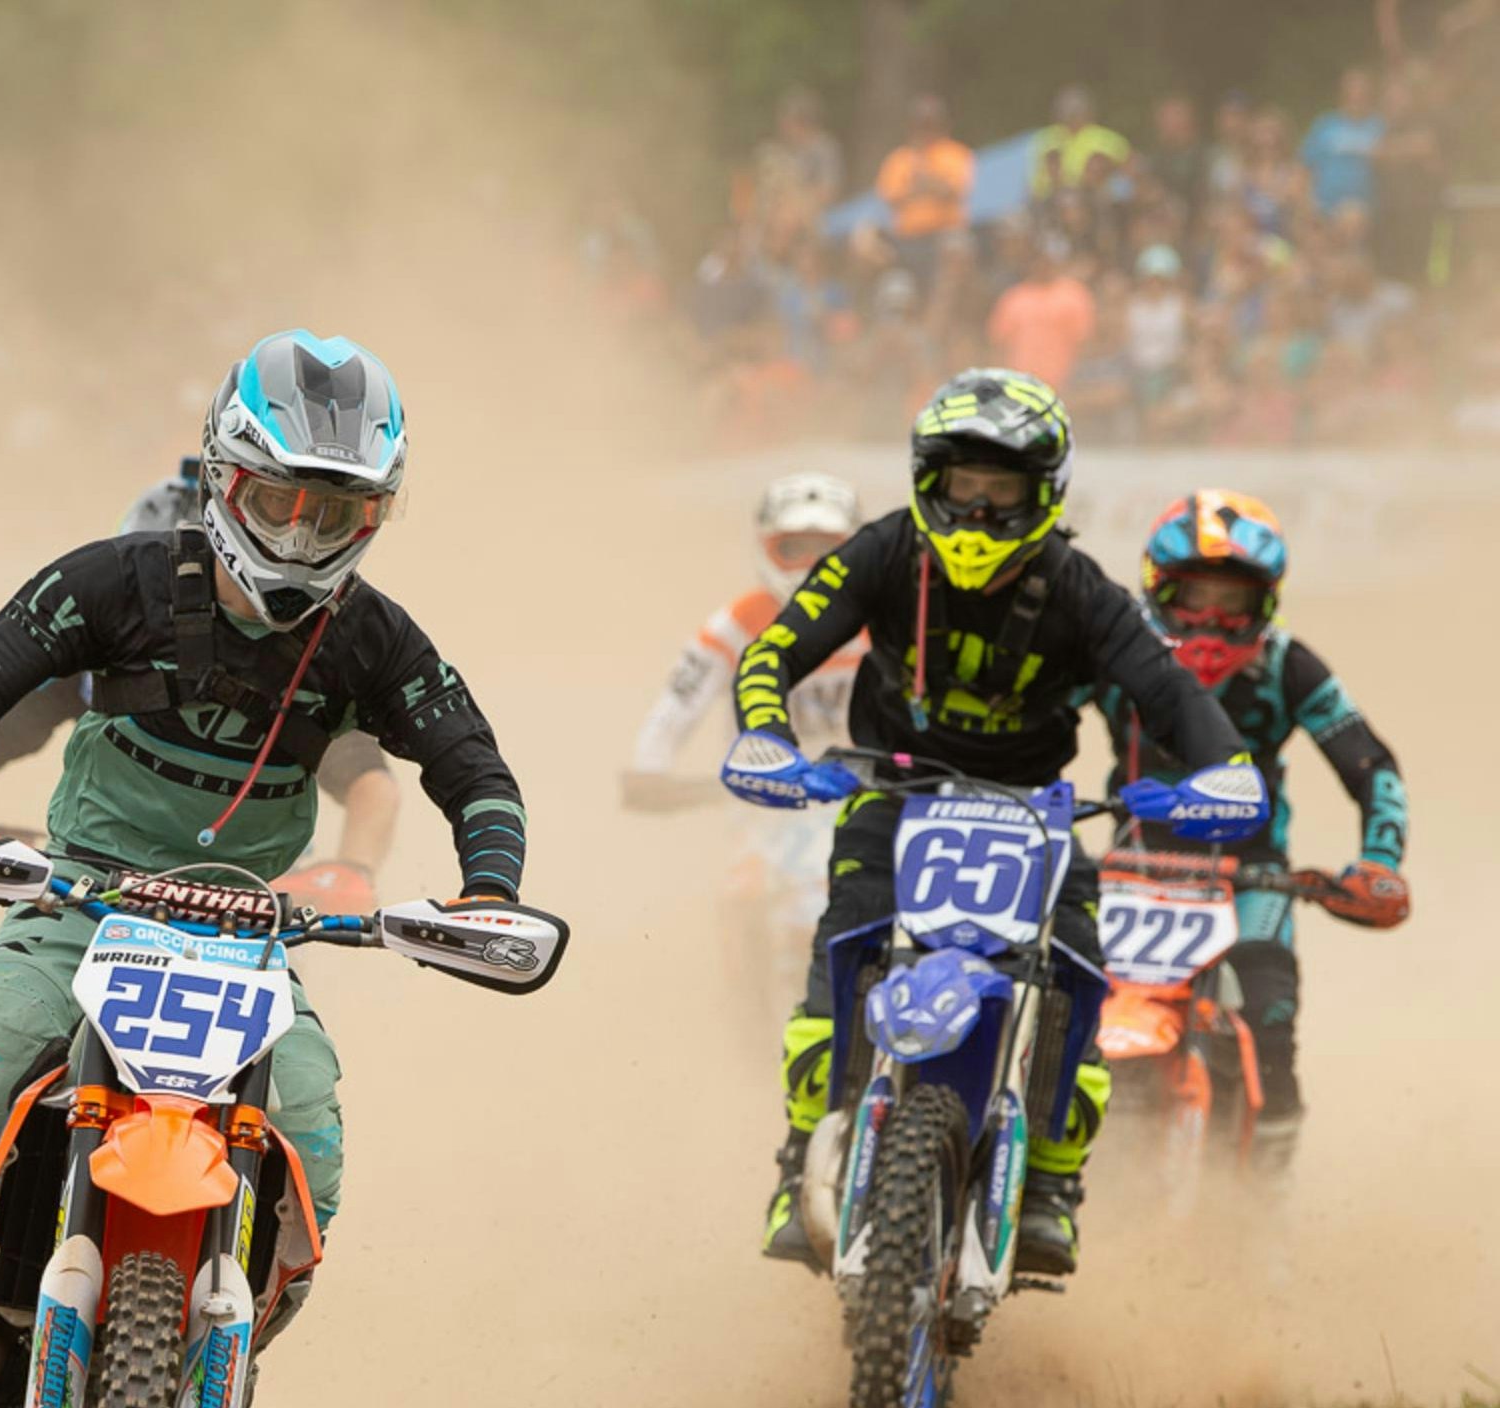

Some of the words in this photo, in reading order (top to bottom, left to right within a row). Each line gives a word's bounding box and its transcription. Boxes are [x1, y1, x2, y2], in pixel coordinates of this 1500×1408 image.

[316, 446, 358, 461] BELL
[111, 732, 164, 772] FLY
[1168, 803, 1260, 820] ACERBIS
[900, 826, 1067, 924] 651
[120, 876, 277, 916] RENTHAL
[1102, 906, 1214, 968] 222
[92, 951, 173, 967] WRIGHT
[98, 966, 275, 1066] 254
